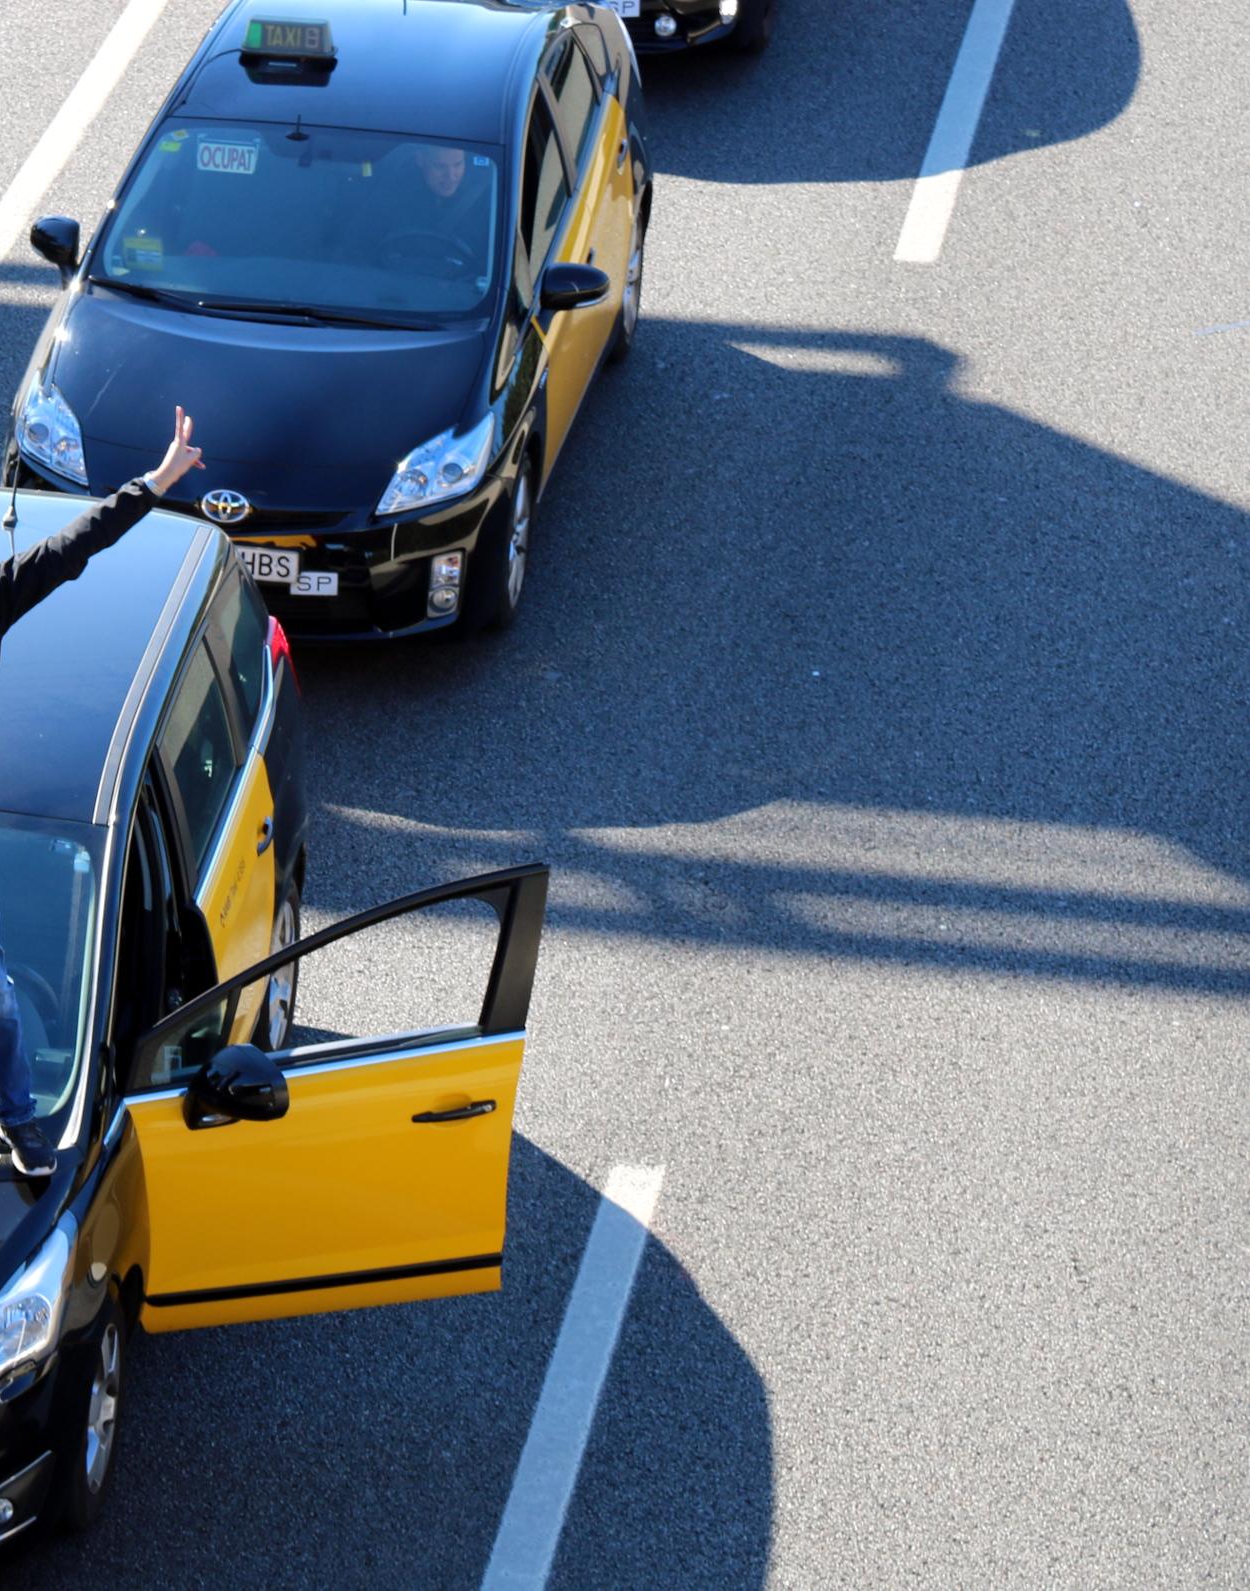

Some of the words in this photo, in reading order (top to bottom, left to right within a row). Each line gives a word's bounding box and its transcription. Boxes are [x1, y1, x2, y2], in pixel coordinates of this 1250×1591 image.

[265, 25, 302, 48] TAXI
[200, 145, 255, 171] OCUPAT
[297, 575, 332, 592] SP
